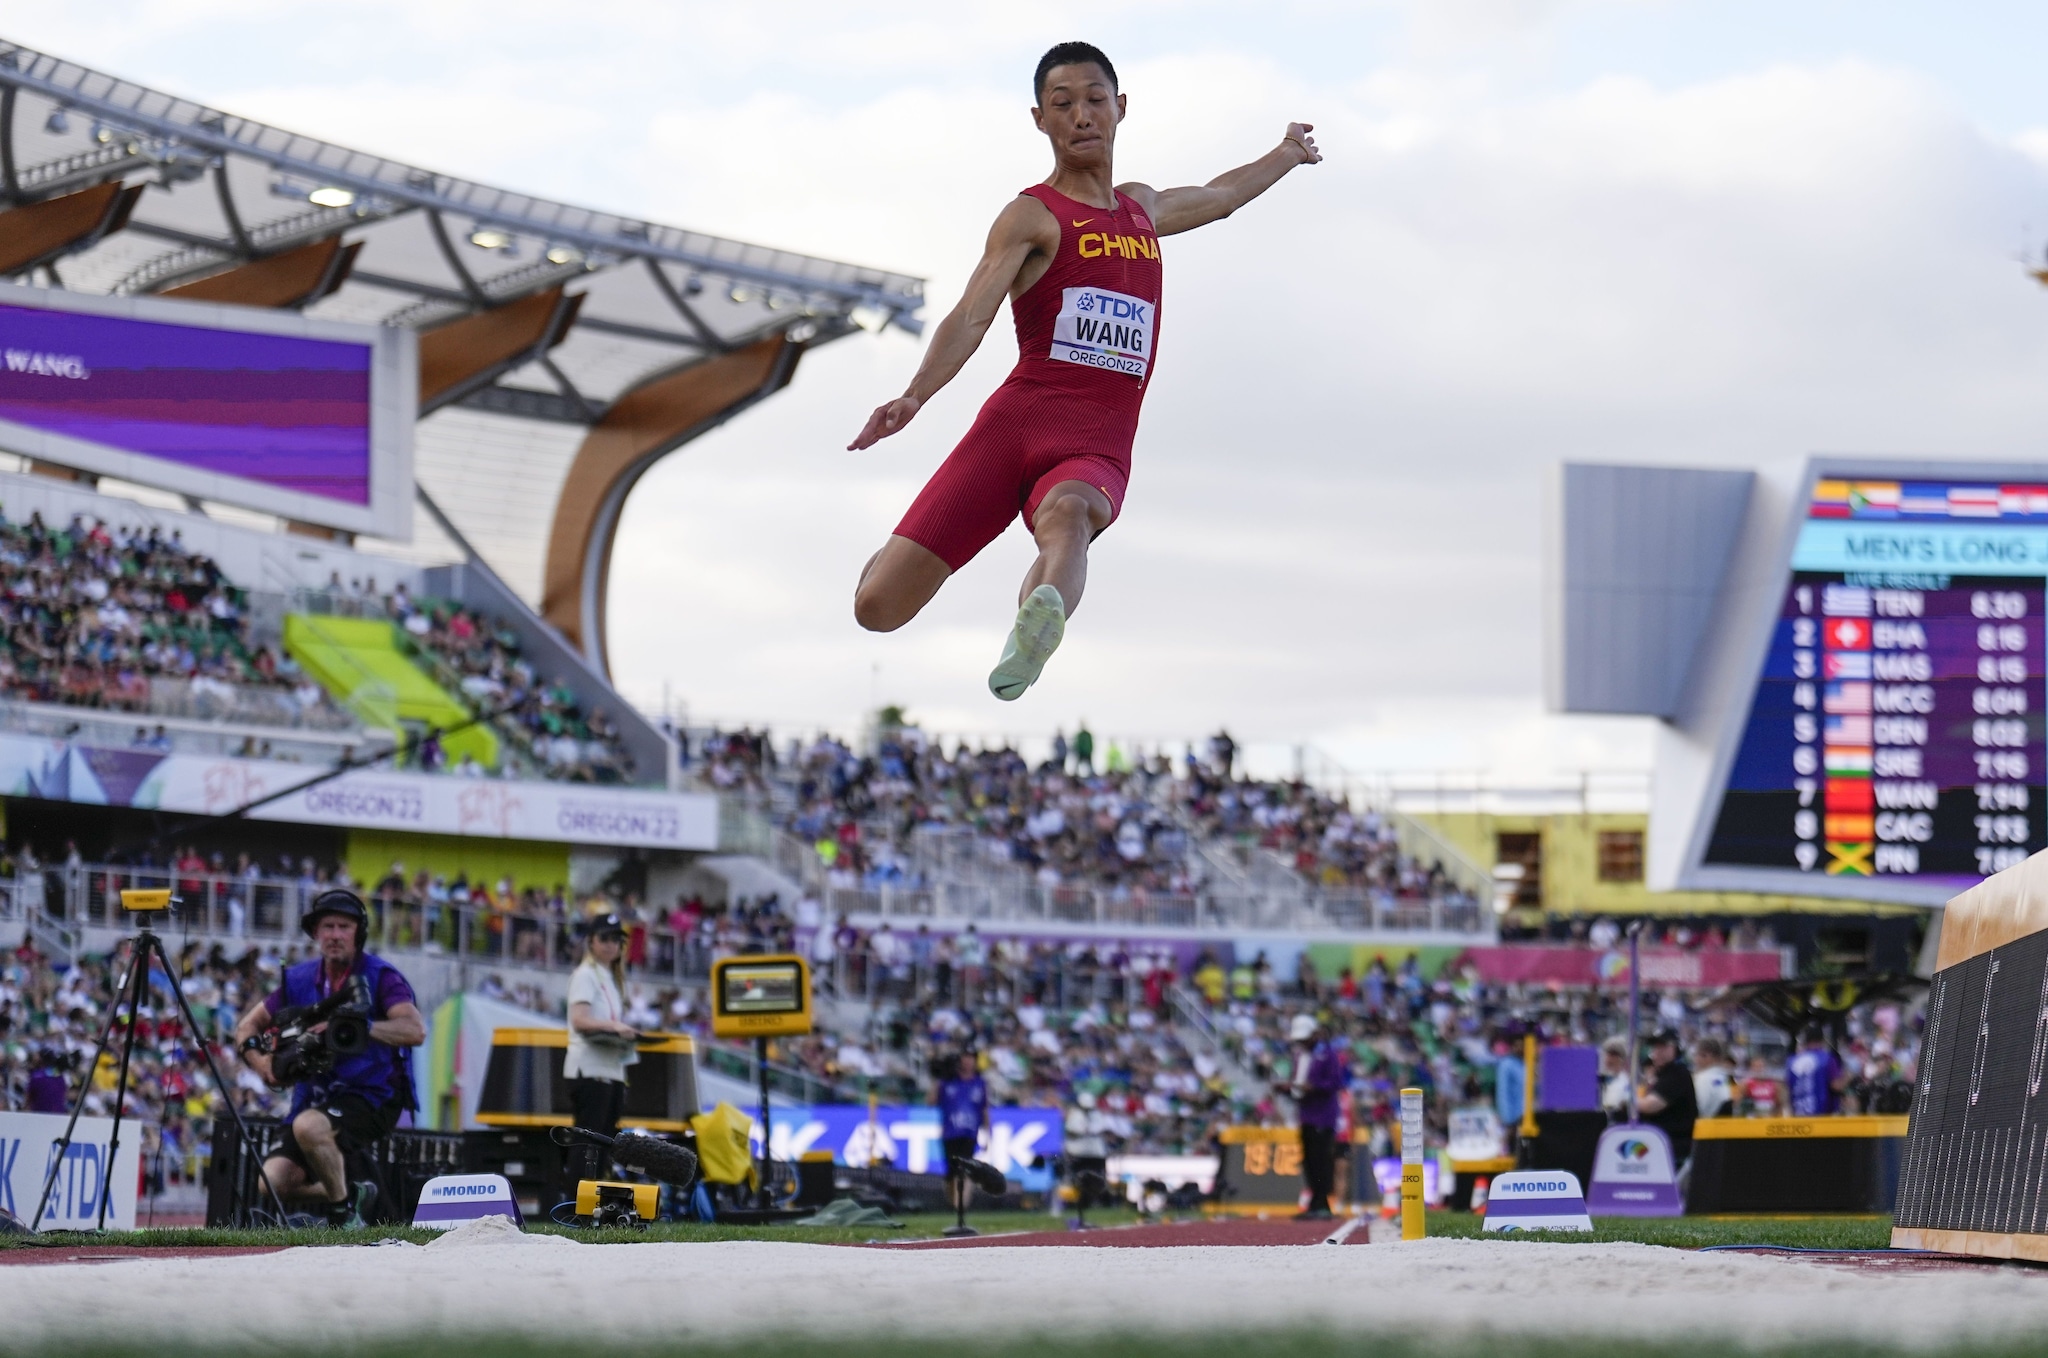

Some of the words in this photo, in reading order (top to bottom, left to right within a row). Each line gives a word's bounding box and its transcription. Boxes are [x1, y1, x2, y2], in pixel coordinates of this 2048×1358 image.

[1079, 232, 1161, 264] CHINA
[1096, 294, 1146, 325] TDK
[1076, 316, 1142, 353] WANG
[1069, 350, 1142, 374] OREGON22
[1845, 535, 1936, 562] MEN'S
[1943, 538, 2028, 564] LONG
[1795, 585, 1813, 614] 1
[1871, 589, 1925, 617] TEN
[1793, 617, 1816, 647] 2
[1873, 620, 1928, 649] EHA
[1793, 649, 1816, 678] 3
[1873, 652, 1933, 681] MAS
[1793, 681, 1816, 710] 4
[1873, 684, 1936, 713] MCC
[1794, 712, 1817, 743] 5
[1874, 715, 1929, 745] DEN
[1793, 745, 1818, 775] 6
[1794, 777, 1817, 807] 7
[1874, 780, 1939, 810] WAN
[1794, 809, 1818, 840] 8
[1794, 842, 1818, 871] 9
[1875, 843, 1920, 874] PIN
[1766, 1124, 1812, 1137] SEIKO
[889, 1120, 1048, 1175] TK
[442, 1184, 497, 1197] MONDO
[1512, 1182, 1567, 1192] MONDO
